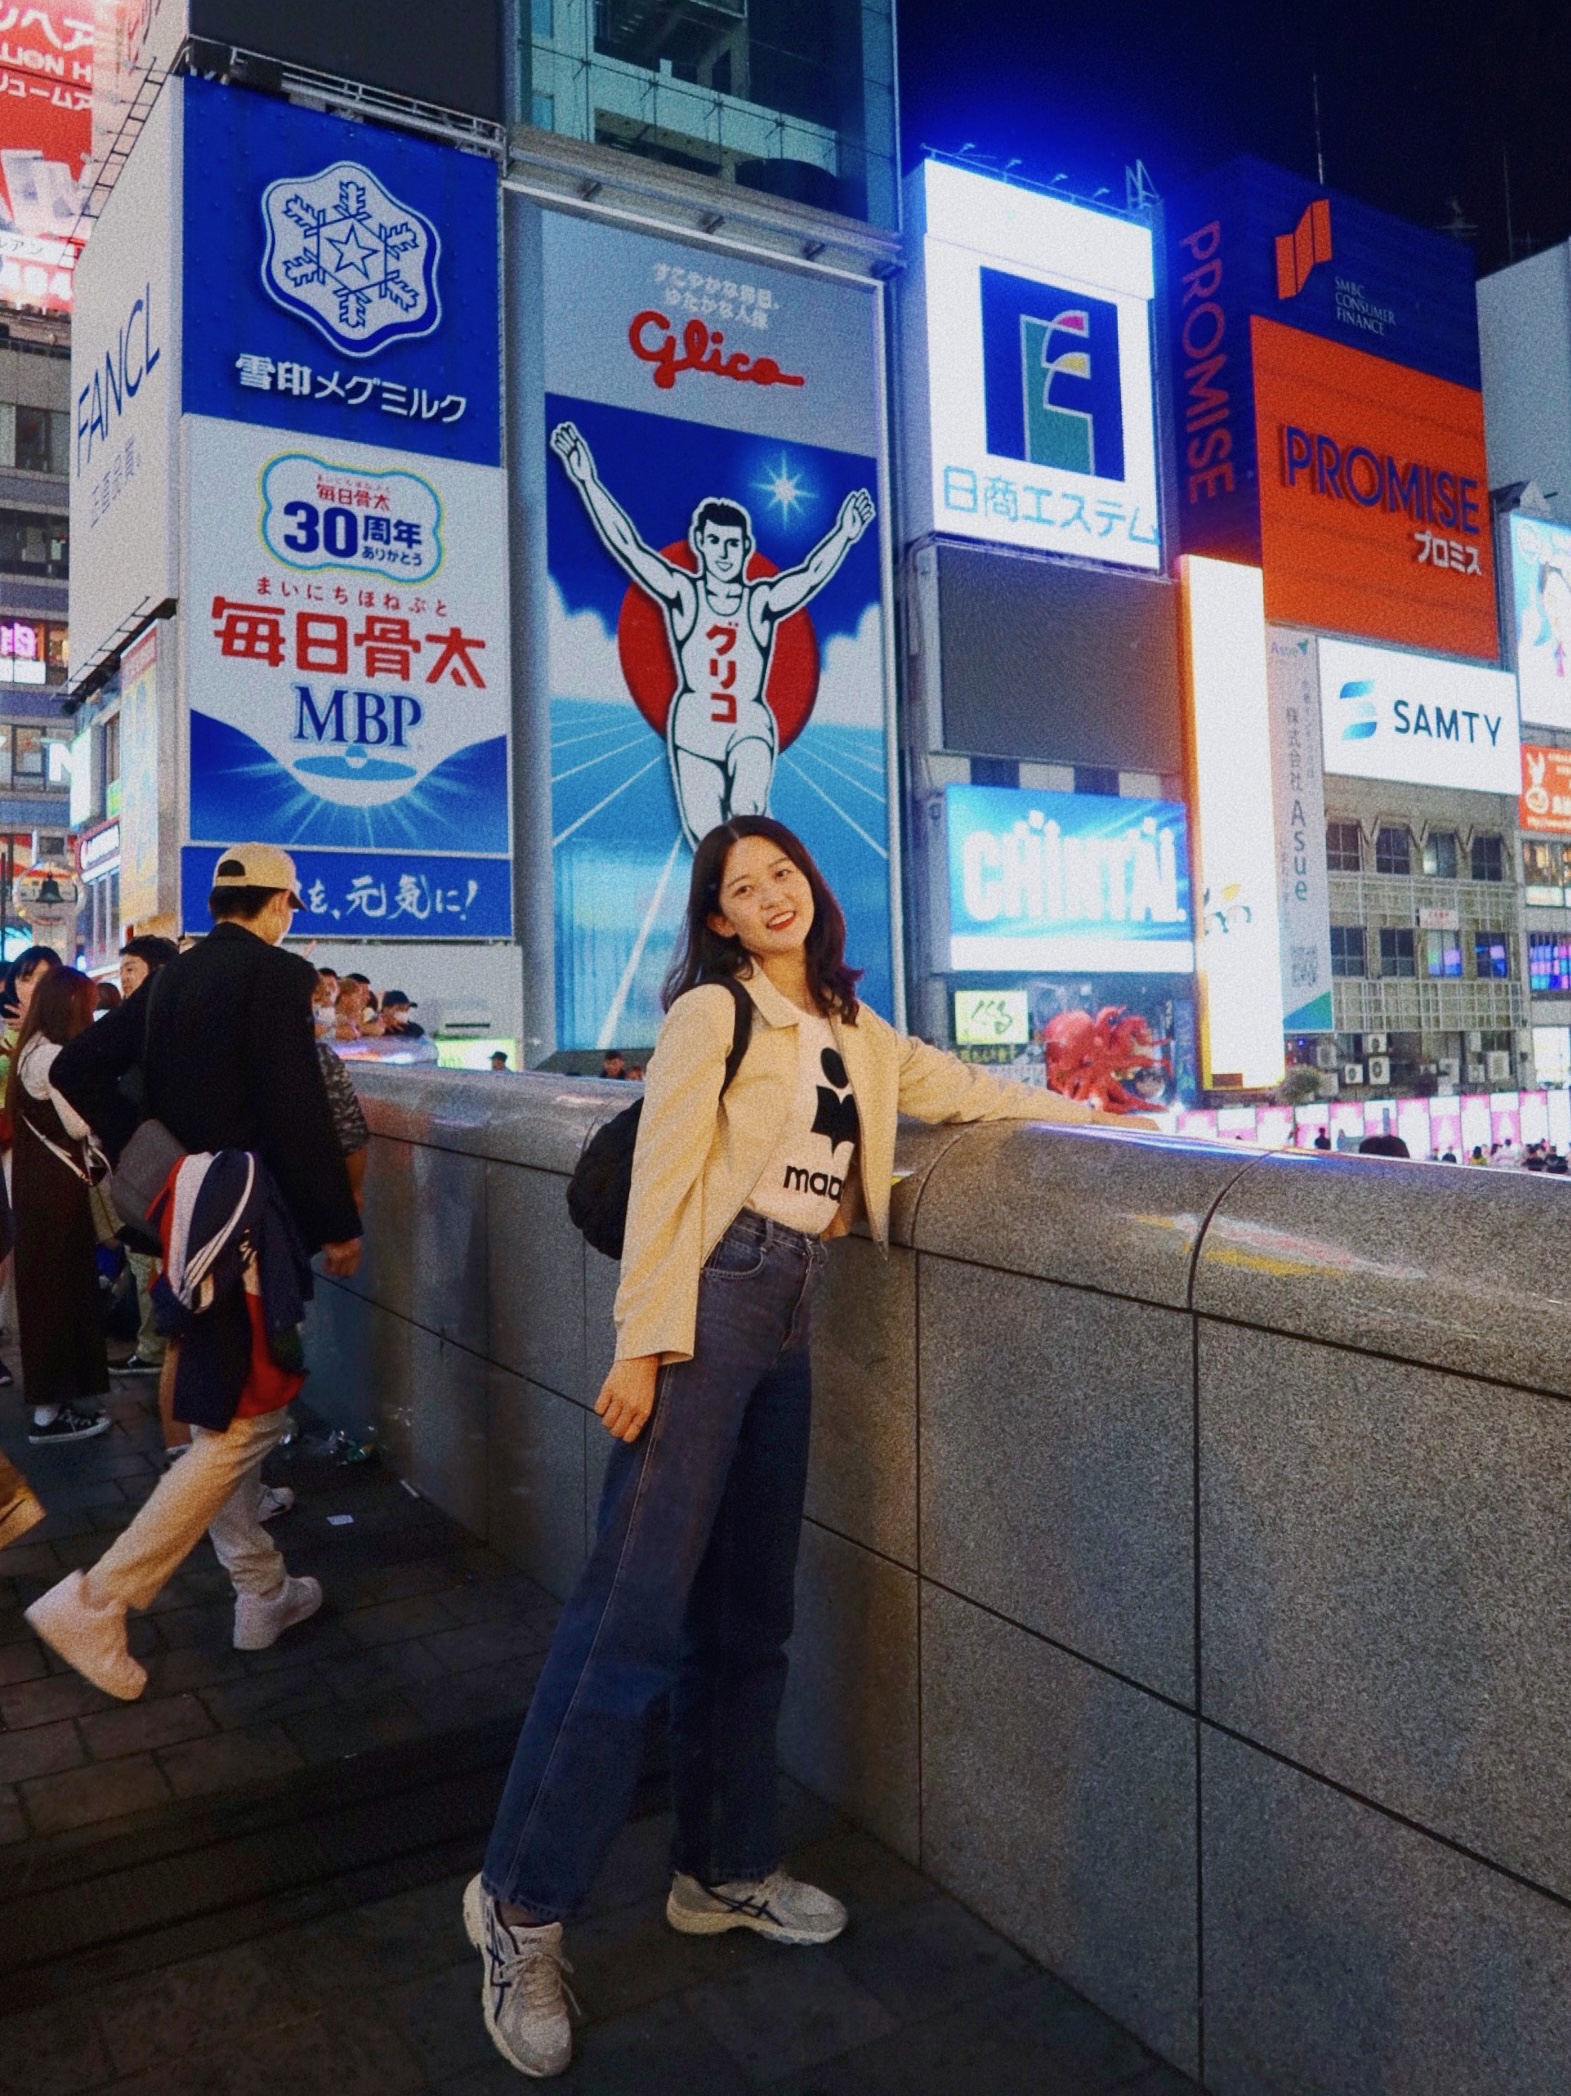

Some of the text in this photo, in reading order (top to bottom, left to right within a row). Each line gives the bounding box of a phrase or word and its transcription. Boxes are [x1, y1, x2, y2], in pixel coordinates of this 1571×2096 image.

[1335, 275, 1365, 299] SMBC
[1335, 292, 1397, 326] CONSUMER
[1336, 306, 1385, 336] FINANCE
[629, 311, 805, 389] Glico
[1180, 220, 1234, 503] PROMISE
[76, 282, 160, 479] FANCL
[235, 352, 467, 423] 雪印メグミルク
[316, 483, 391, 511] 毎日骨太
[1284, 425, 1481, 535] PROMISE
[283, 501, 423, 558] 30周年
[1414, 530, 1483, 576] プロミス
[257, 576, 448, 617] まいにちほねぶと
[211, 595, 487, 690] 毎日骨太
[705, 621, 738, 723] グリコ
[293, 685, 422, 747] MBP
[1393, 699, 1502, 747] SAMTY
[293, 874, 478, 920] を、元気に!
